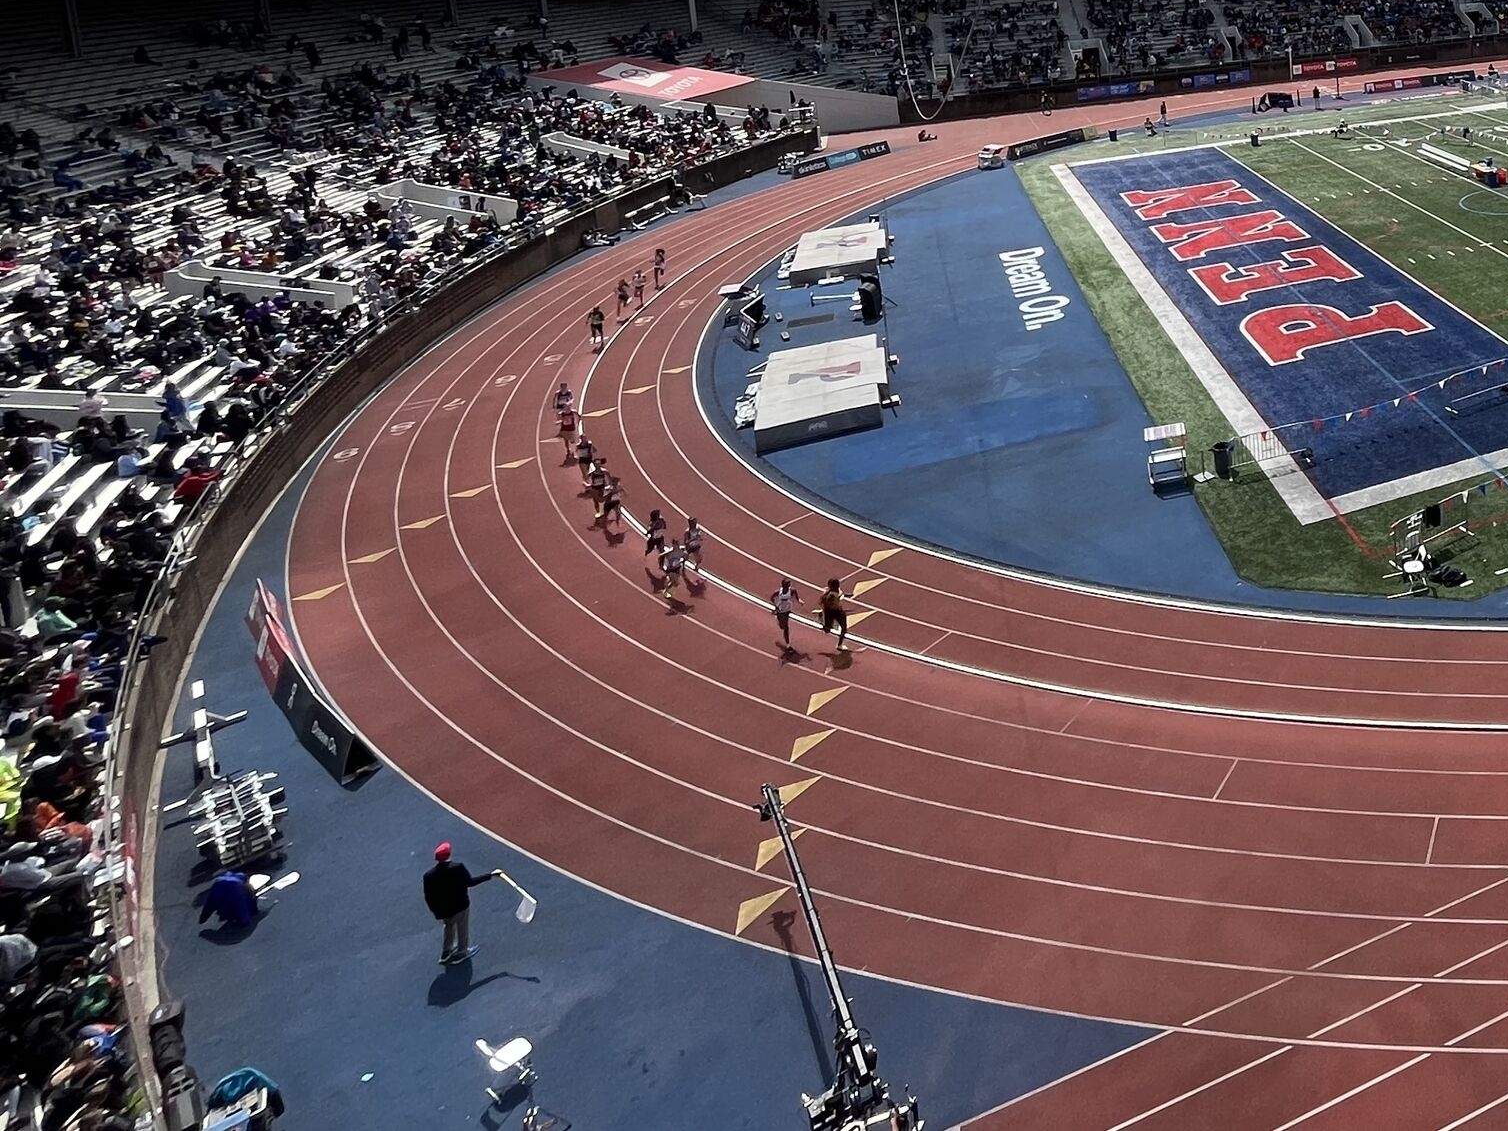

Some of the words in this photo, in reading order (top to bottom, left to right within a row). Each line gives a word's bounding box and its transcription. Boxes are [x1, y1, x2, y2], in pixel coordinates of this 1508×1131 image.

[1303, 64, 1325, 72] TOYOTA
[1337, 60, 1357, 68] TOYOTA
[656, 76, 705, 96] TOYOTA
[862, 144, 886, 155] TIMEX
[998, 246, 1052, 298] Dream
[1119, 179, 1435, 366] PENN
[1018, 295, 1071, 331] On.
